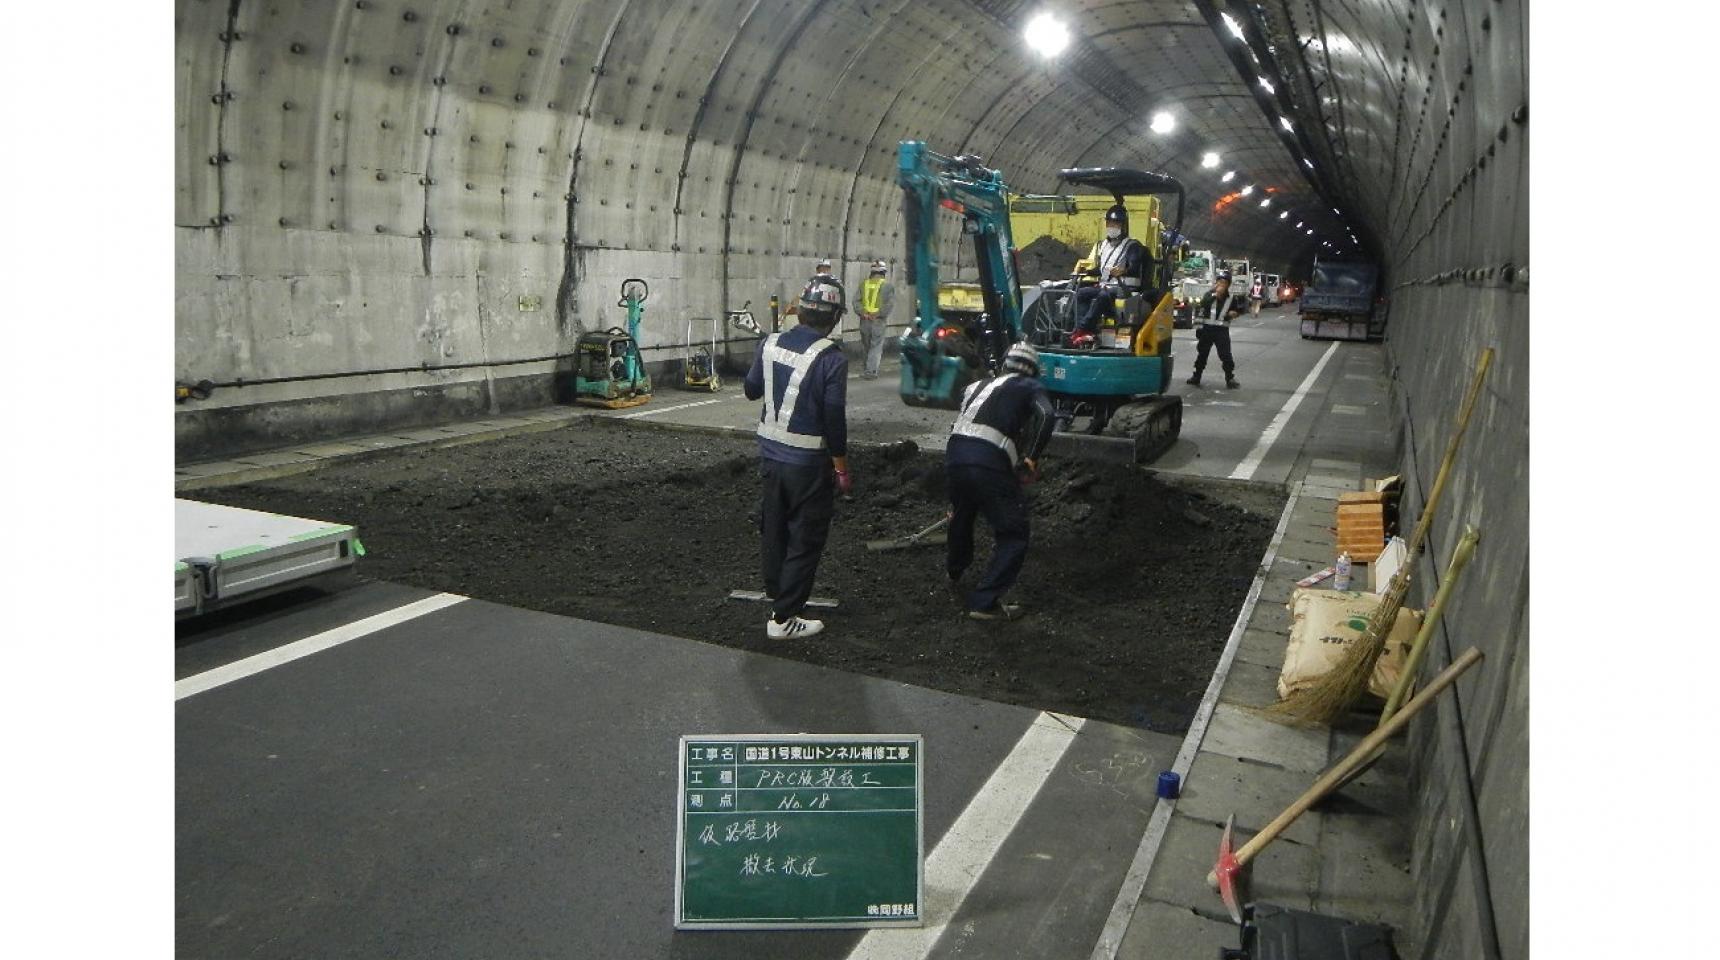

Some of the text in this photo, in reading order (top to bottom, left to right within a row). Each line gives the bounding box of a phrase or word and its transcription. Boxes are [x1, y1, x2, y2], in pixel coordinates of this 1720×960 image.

[691, 746, 734, 761] 工事名
[745, 746, 911, 761] 国道1号東山トンネル補修工事
